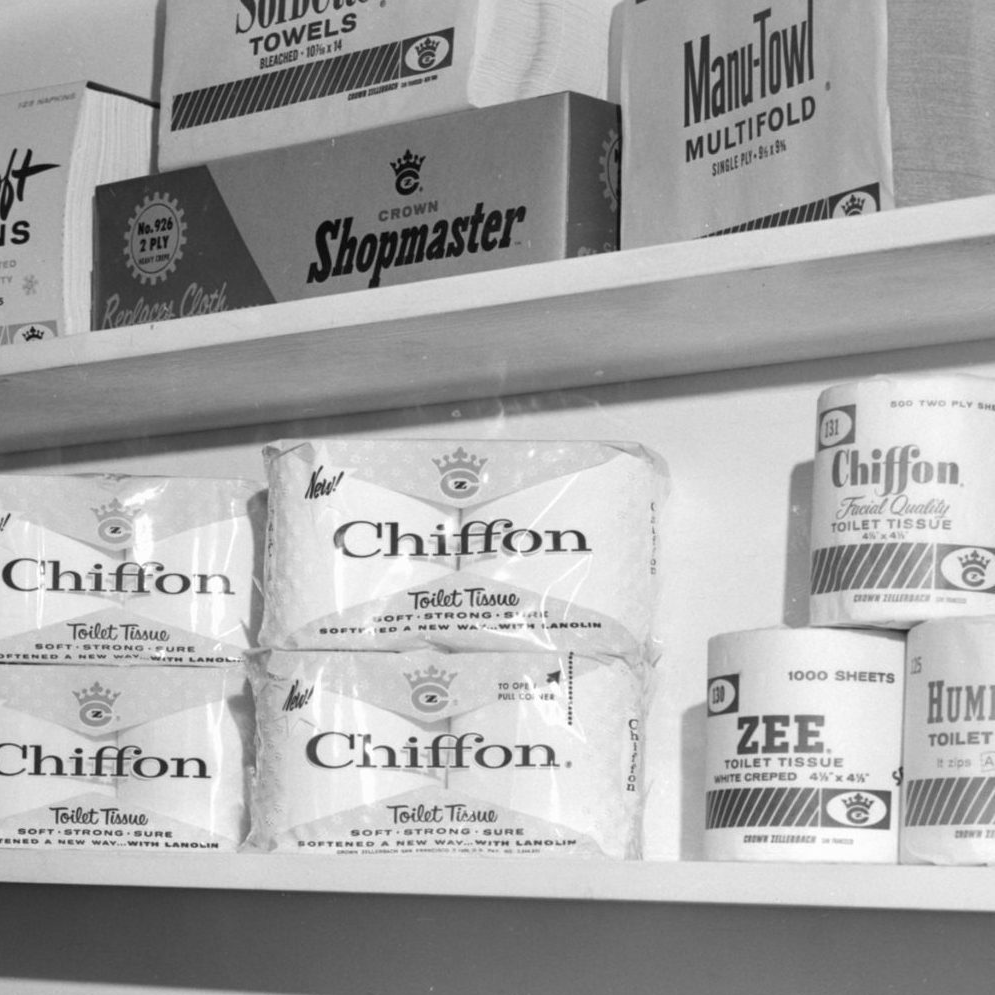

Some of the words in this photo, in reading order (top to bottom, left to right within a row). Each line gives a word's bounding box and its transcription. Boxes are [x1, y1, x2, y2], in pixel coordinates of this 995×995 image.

[249, 13, 357, 56] TOWELS
[259, 49, 299, 70] BLEACHED
[334, 39, 342, 52] 14
[684, 0, 814, 128] Manu-Towl
[685, 96, 816, 163] MULTIFOLD
[712, 155, 738, 177] SINGLE
[740, 150, 753, 167] PLY
[378, 200, 438, 222] CROWN
[139, 239, 146, 252] 2
[149, 235, 169, 251] PLY
[306, 202, 526, 288] Shopmaster
[890, 400, 913, 408] 500
[919, 400, 946, 408] TWO
[951, 400, 973, 409] PLY
[824, 419, 839, 438] 131
[832, 444, 960, 497] Chiffon
[304, 465, 344, 500] New!
[836, 495, 889, 520] Facial
[890, 494, 951, 520] Quality
[831, 519, 881, 533] TOILET
[887, 518, 953, 530] TISSUE
[332, 519, 593, 558] Chiffon
[1, 557, 235, 596] Chiffon
[407, 589, 463, 611] Toilet
[463, 588, 520, 608] Tissue
[423, 611, 493, 621] STRONG
[66, 622, 119, 641] Toilet
[121, 623, 170, 642] Tissue
[34, 642, 72, 651] SOFT
[82, 643, 144, 652] STRONG
[497, 682, 509, 690] TO
[788, 671, 828, 681] 1000
[835, 671, 895, 684] SHEETS
[282, 680, 315, 712] New!
[497, 692, 515, 700] PULL
[711, 685, 725, 705] 130
[737, 714, 825, 755] ZEE
[928, 731, 993, 747] TOILET
[305, 731, 561, 769] Chiffon
[724, 757, 771, 769] TOILET
[778, 757, 844, 768] TISSUE
[948, 757, 972, 770] zips
[714, 772, 742, 784] WHITE
[744, 772, 797, 782] CREPED
[49, 806, 100, 825] Toilet
[100, 807, 149, 826] Tissue
[386, 804, 444, 825] Toilet
[445, 803, 498, 823] Tissue
[17, 828, 55, 836] SOFT
[63, 828, 124, 837] STRONG
[134, 829, 173, 838] SURE
[350, 828, 392, 837] SOFT
[404, 827, 471, 836] STRONG
[482, 827, 525, 836] SURE
[165, 841, 219, 849] LANOLIN
[297, 839, 375, 848] SOFTENED
[396, 839, 427, 847] NEW
[515, 839, 577, 847] LANOLIN
